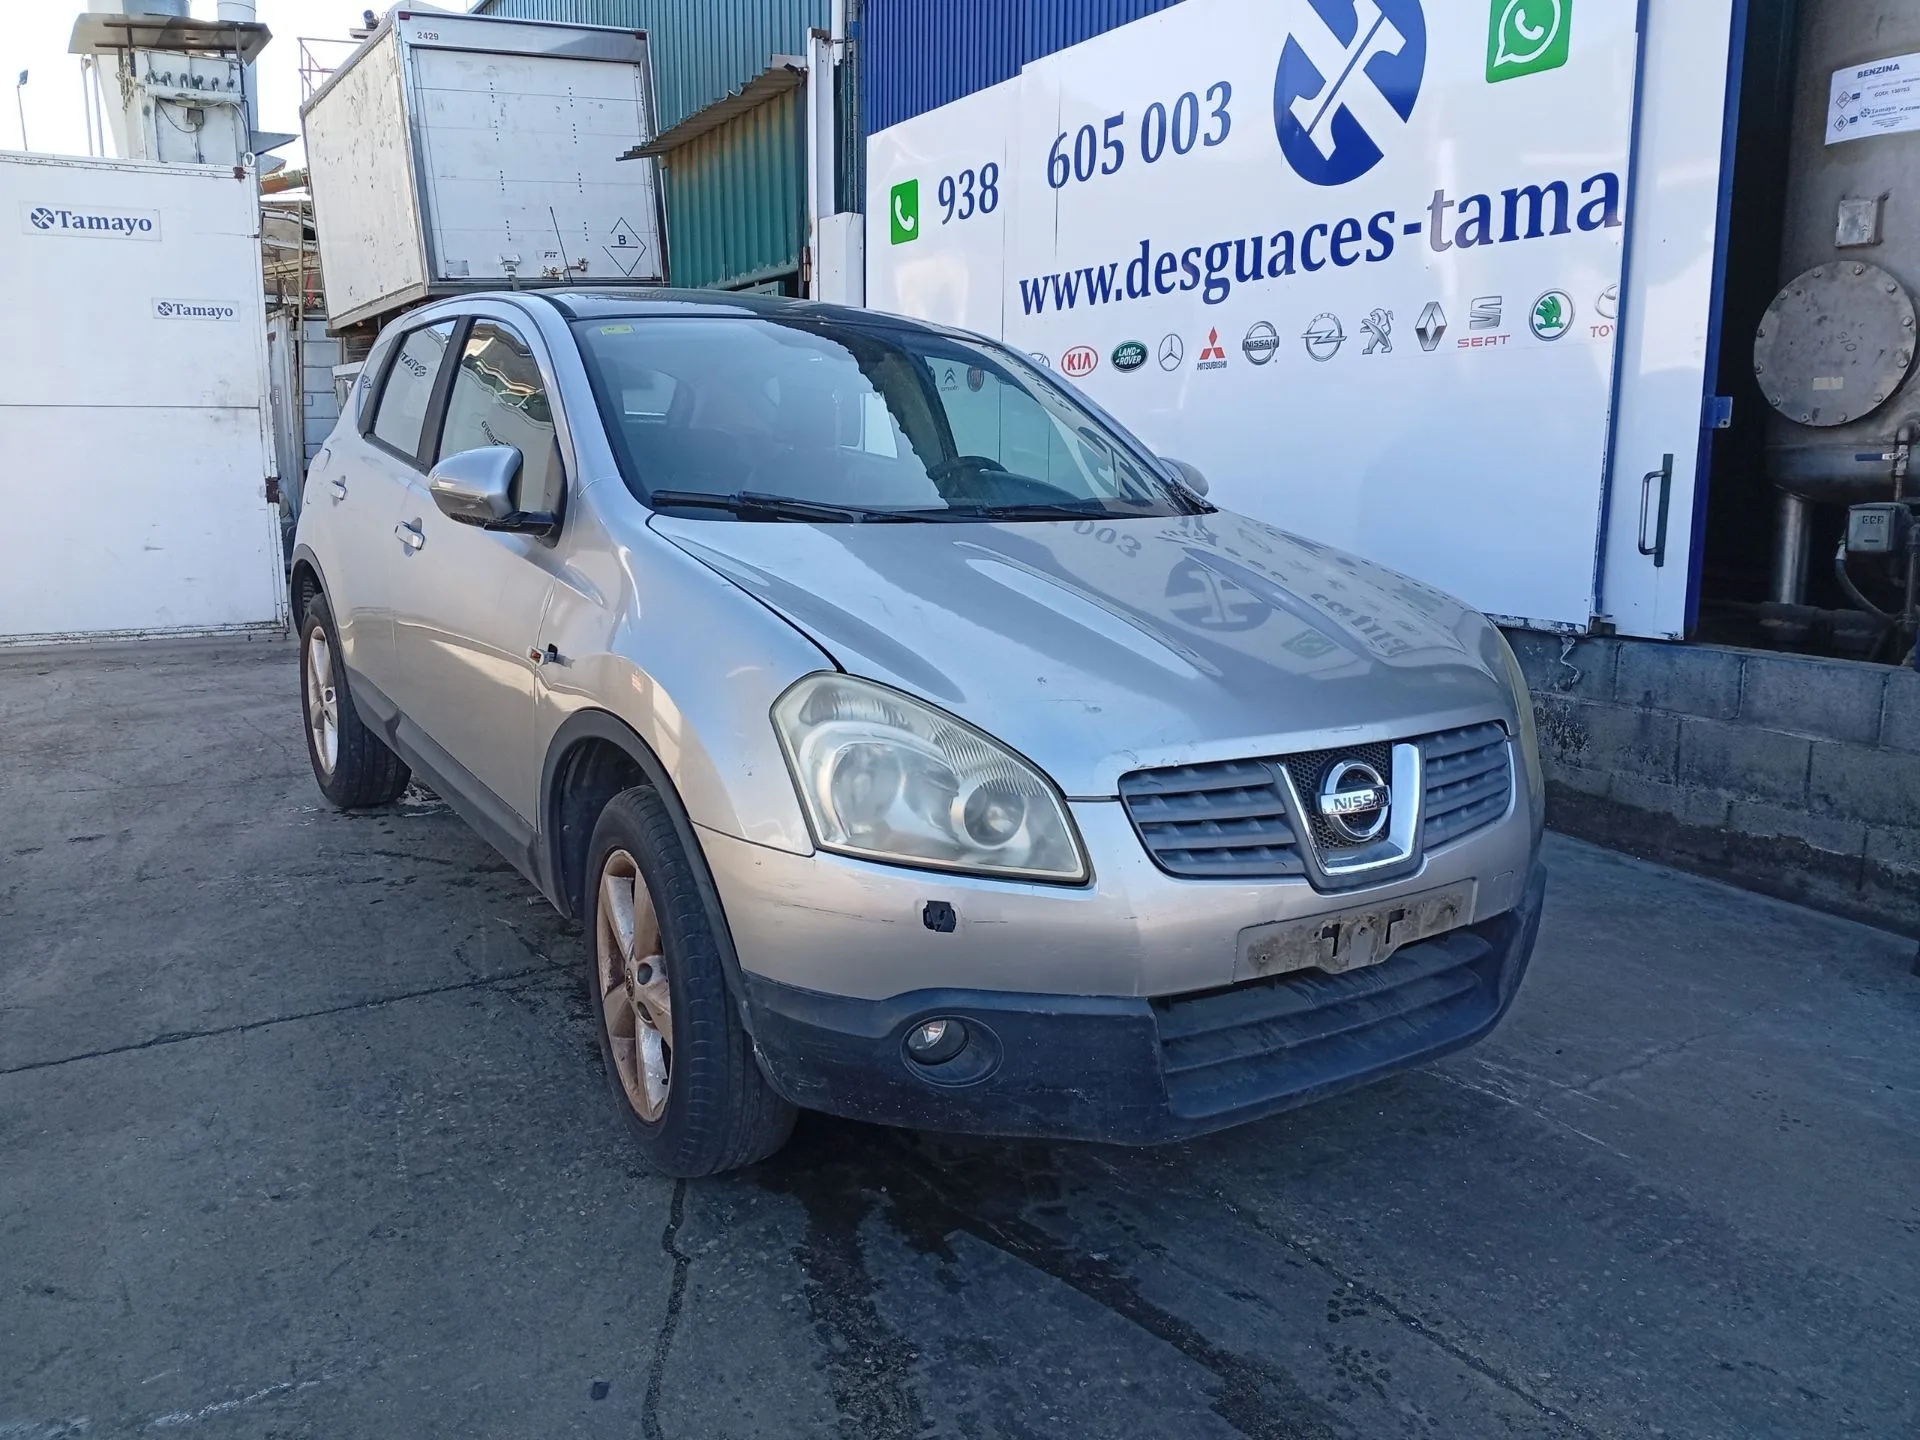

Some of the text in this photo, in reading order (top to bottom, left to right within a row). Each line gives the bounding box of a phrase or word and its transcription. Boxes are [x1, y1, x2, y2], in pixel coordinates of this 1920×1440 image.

[417, 31, 439, 40] 2429
[1857, 64, 1900, 79] BENZINA
[938, 81, 1232, 225] 938 605 003
[55, 210, 153, 236] Tamayo
[618, 235, 627, 245] B
[172, 303, 234, 320] Tamayo
[1589, 324, 1614, 338] TO
[1245, 338, 1276, 348] NISSAN
[1457, 334, 1511, 349] SEAT
[1118, 346, 1136, 357] LAND
[1067, 352, 1092, 371] KIA
[1120, 355, 1142, 366] ROVER
[1196, 360, 1228, 371] MITSUBISHI
[1333, 789, 1389, 811] NISSAN
